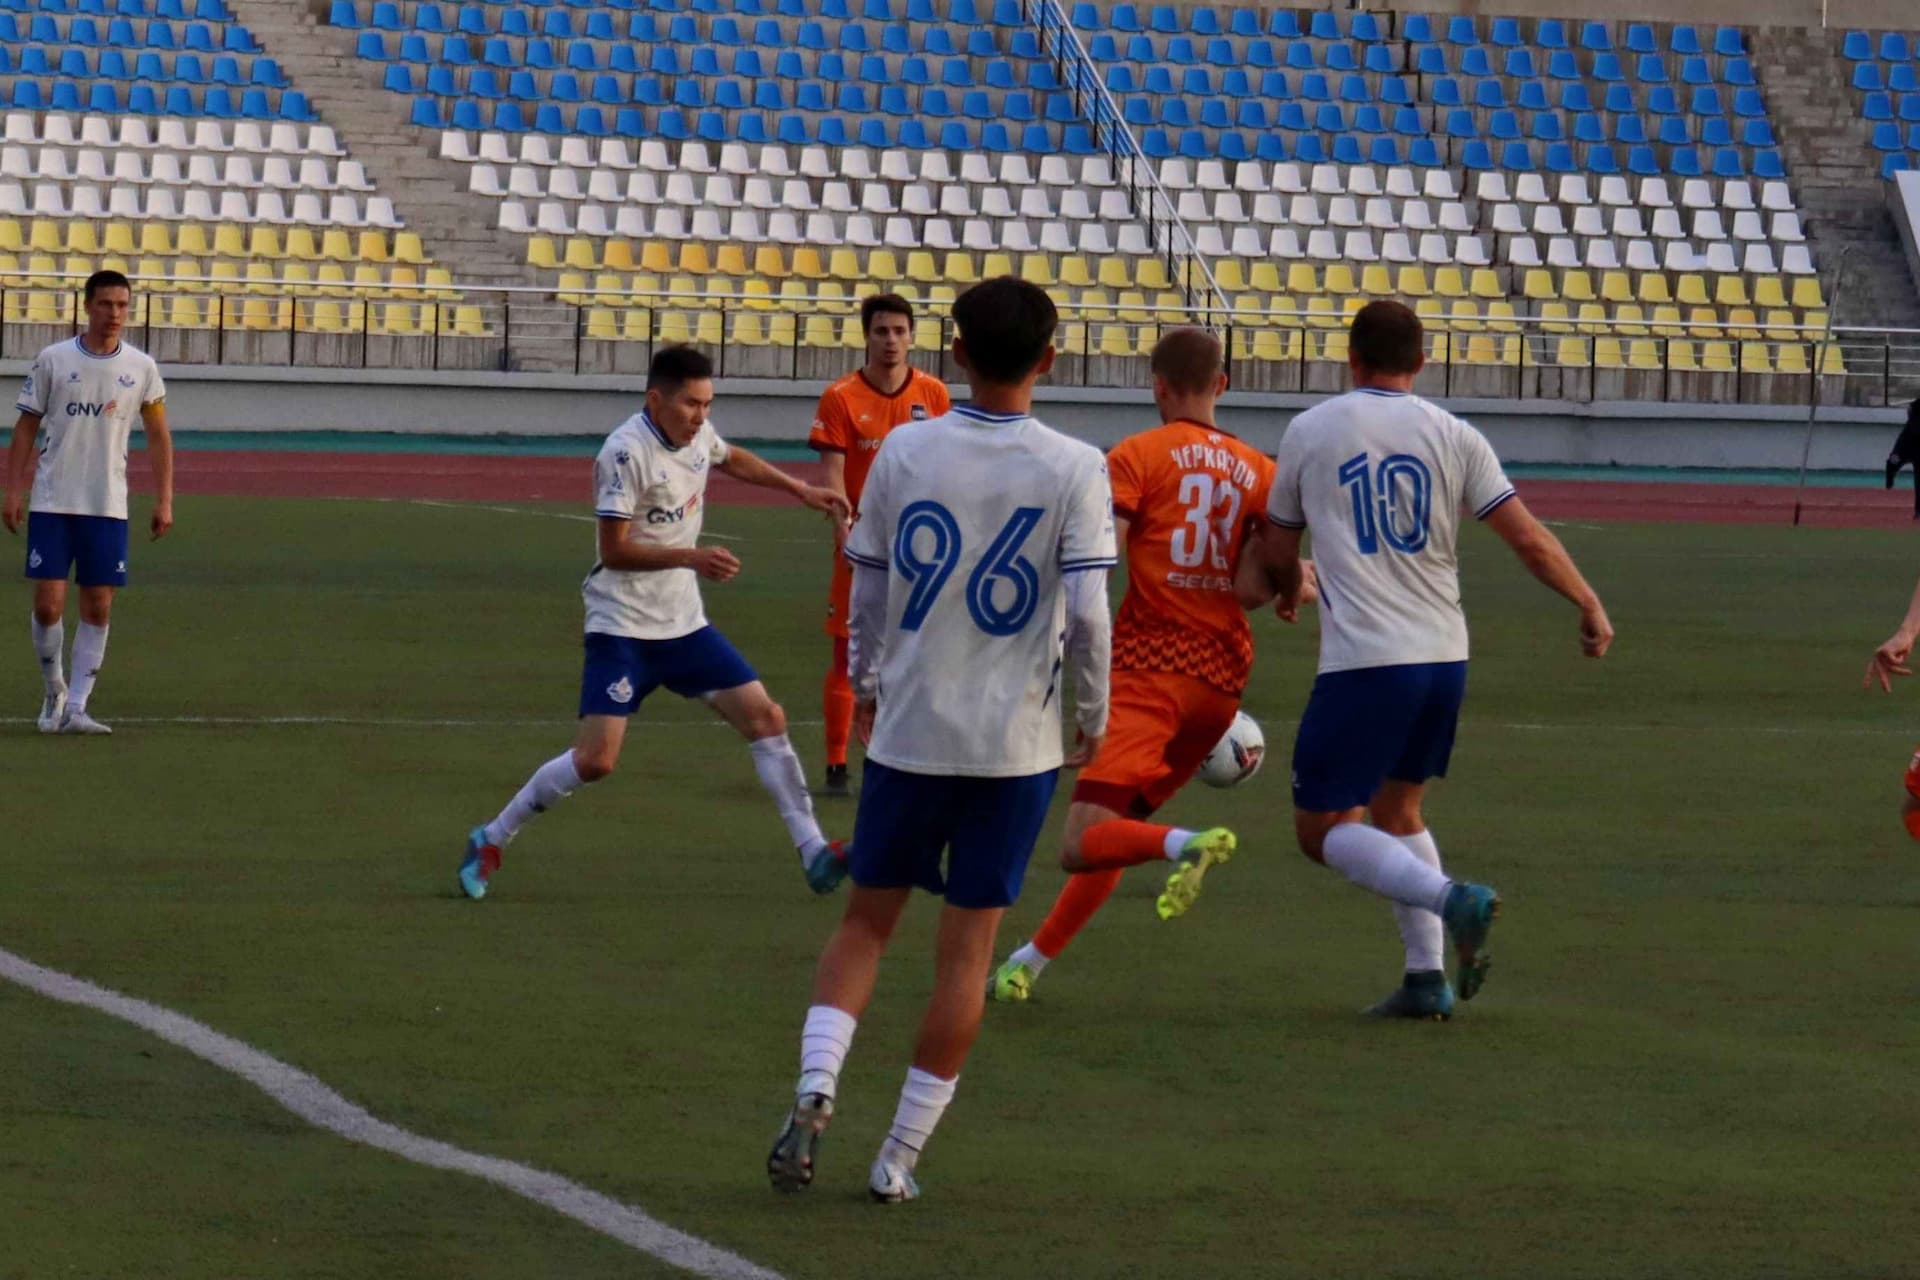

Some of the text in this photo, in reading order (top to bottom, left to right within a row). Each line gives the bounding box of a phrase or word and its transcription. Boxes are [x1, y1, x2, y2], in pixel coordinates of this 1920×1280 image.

[66, 402, 104, 416] GNV
[1171, 443, 1257, 490] ЧЕРКАСОВ
[1338, 452, 1432, 555] 10
[894, 500, 1046, 637] 96
